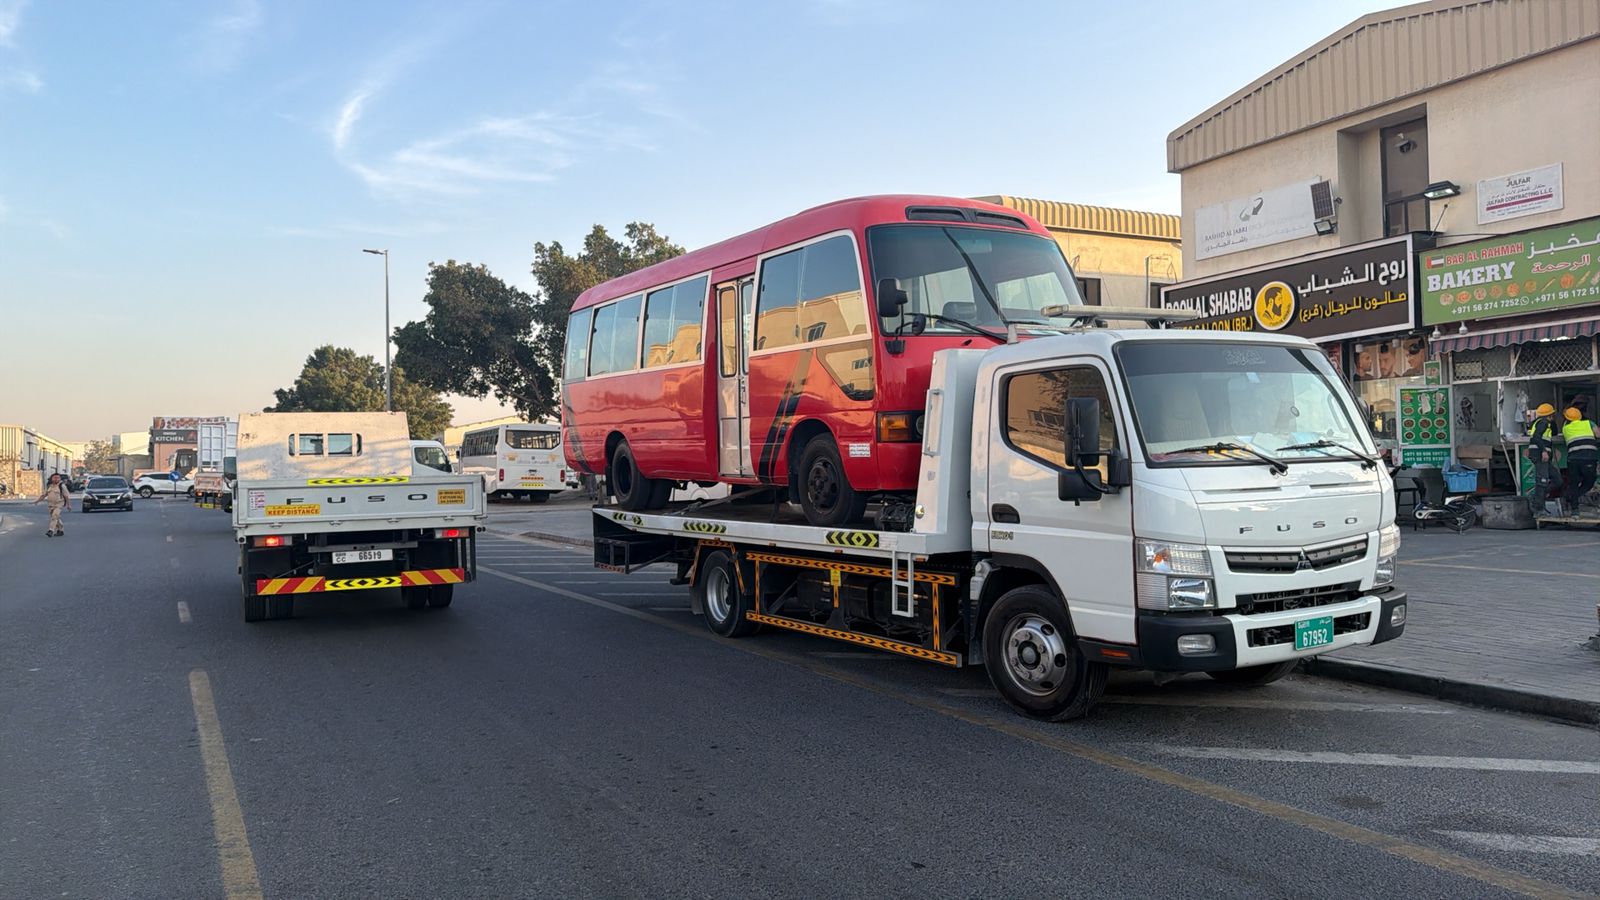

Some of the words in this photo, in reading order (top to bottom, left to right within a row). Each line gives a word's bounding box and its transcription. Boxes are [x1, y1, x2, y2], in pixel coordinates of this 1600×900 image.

[1506, 177, 1532, 188] JULFAR
[1486, 198, 1504, 206] JULFAR
[1505, 191, 1539, 202] CONTRACTING
[1205, 231, 1225, 241] RASHID
[1446, 255, 1464, 266] BAB
[1466, 251, 1479, 263] AL
[1481, 242, 1524, 260] RAHMAH
[1532, 253, 1591, 274] الرحمة
[1297, 262, 1375, 298] الشباب
[1379, 259, 1406, 285] روح
[1427, 261, 1516, 292] BAKERY
[1197, 295, 1209, 319] AL
[1209, 286, 1252, 317] SHABAB
[1325, 295, 1362, 318] للرجال
[1364, 290, 1407, 310] صالون
[1451, 306, 1471, 315] +971
[1473, 304, 1483, 312] 56
[1484, 301, 1498, 310] 274
[1500, 298, 1520, 307] 7252
[1558, 291, 1569, 299] 56
[1571, 288, 1588, 298] 172
[1300, 305, 1323, 323] (فرع)
[286, 493, 428, 505] FUSO
[1239, 516, 1358, 535] FUSO
[1303, 628, 1328, 647] 67952
